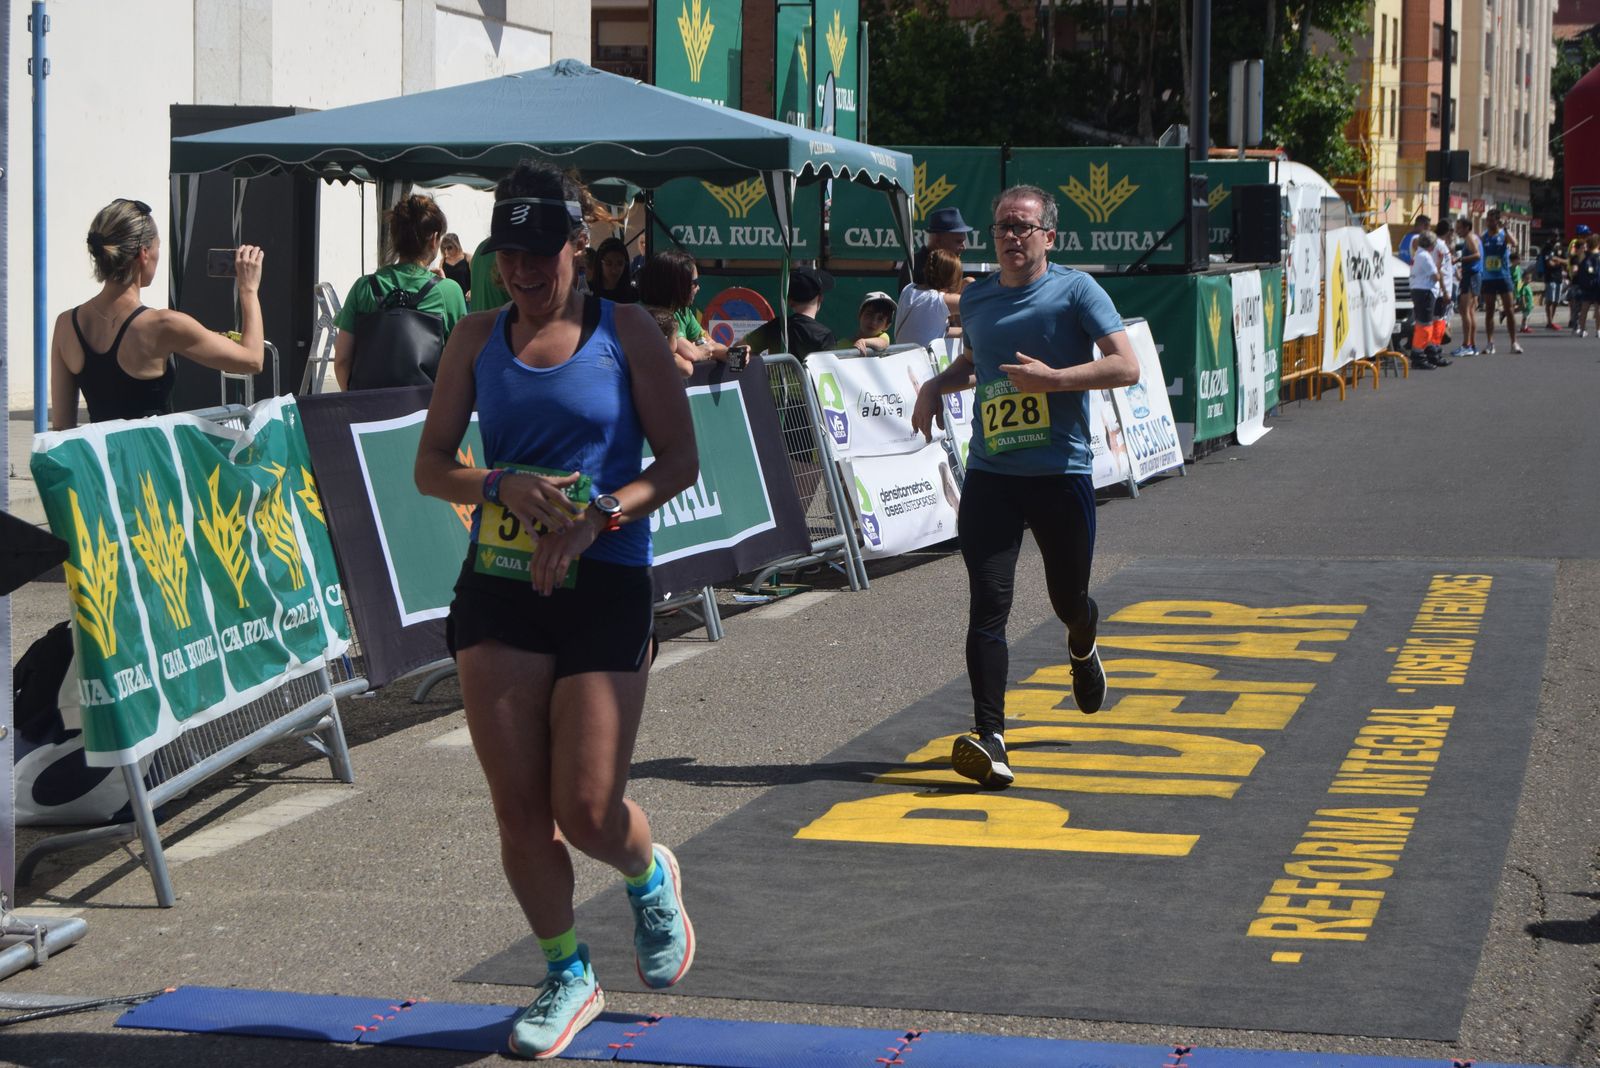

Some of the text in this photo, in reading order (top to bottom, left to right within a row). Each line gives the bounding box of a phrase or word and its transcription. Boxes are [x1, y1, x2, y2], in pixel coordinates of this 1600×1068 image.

[670, 226, 722, 246] CAJA
[845, 228, 900, 248] CAJA
[1091, 231, 1172, 252] RURAL
[986, 396, 1041, 432] 228
[998, 433, 1046, 446] CAJA RURAL
[1126, 415, 1176, 461] OCEANIC
[884, 503, 904, 518] osea
[496, 554, 523, 570] CAJA
[162, 635, 218, 680] CAJA RURAL
[793, 600, 1368, 856] PIDEPAR
[1247, 574, 1494, 941] REFORMA INTEGRAL DISEÑO INTERIORES
